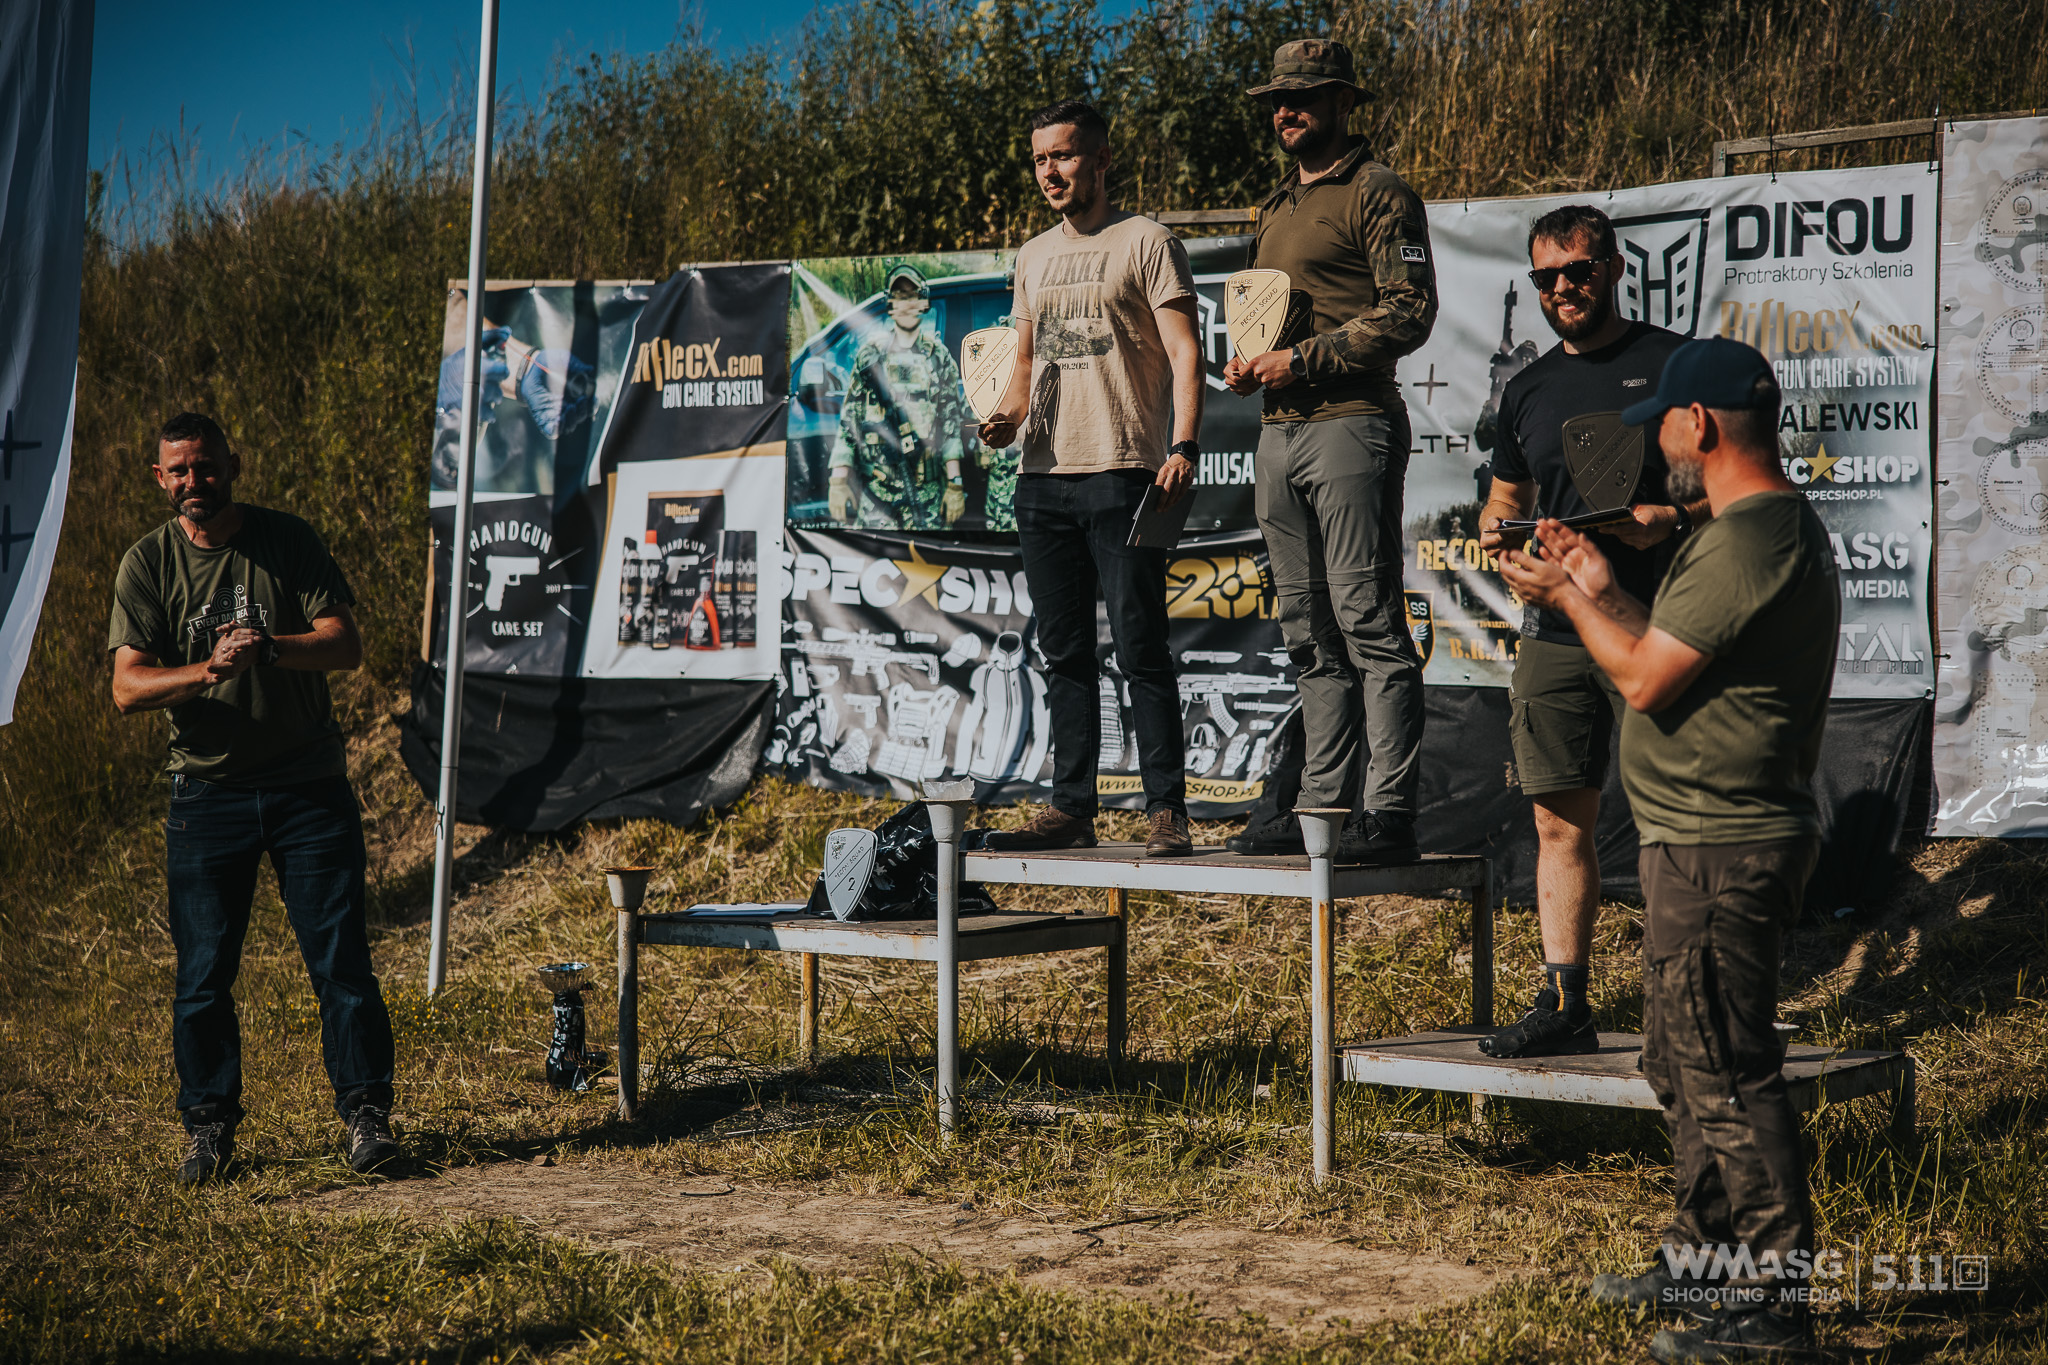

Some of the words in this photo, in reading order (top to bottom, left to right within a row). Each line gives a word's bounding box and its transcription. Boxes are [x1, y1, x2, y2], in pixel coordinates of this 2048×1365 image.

[1725, 193, 1914, 262] DIFOU
[1725, 264, 1827, 285] Protraktory
[1832, 260, 1913, 280] Szkolenia
[1240, 307, 1259, 327] RECON
[1259, 287, 1278, 308] SQUAD
[1260, 323, 1265, 338] 1
[1773, 360, 1806, 389] GUN
[1810, 358, 1851, 388] CARE
[1856, 356, 1919, 387] SYSTEM
[662, 383, 682, 409] GUN
[684, 382, 715, 407] CARE
[716, 379, 763, 407] SYSTEM
[1779, 402, 1919, 433] ALEWSKI
[1616, 470, 1627, 488] 3
[1833, 455, 1920, 484] SHOP
[1801, 489, 1883, 500] SPECSHOP.PL
[469, 520, 552, 554] HANDGUN
[661, 538, 707, 555] HANDGUN
[1829, 531, 1910, 570] ASG
[938, 565, 1034, 617] SHO
[1845, 579, 1910, 599] MEDIA
[195, 615, 219, 629] EVERY
[221, 612, 235, 623] DAY
[236, 608, 256, 619] READY
[492, 621, 521, 636] CARE
[523, 621, 544, 637] SET
[1837, 623, 1924, 661] TAL
[848, 877, 856, 891] 2
